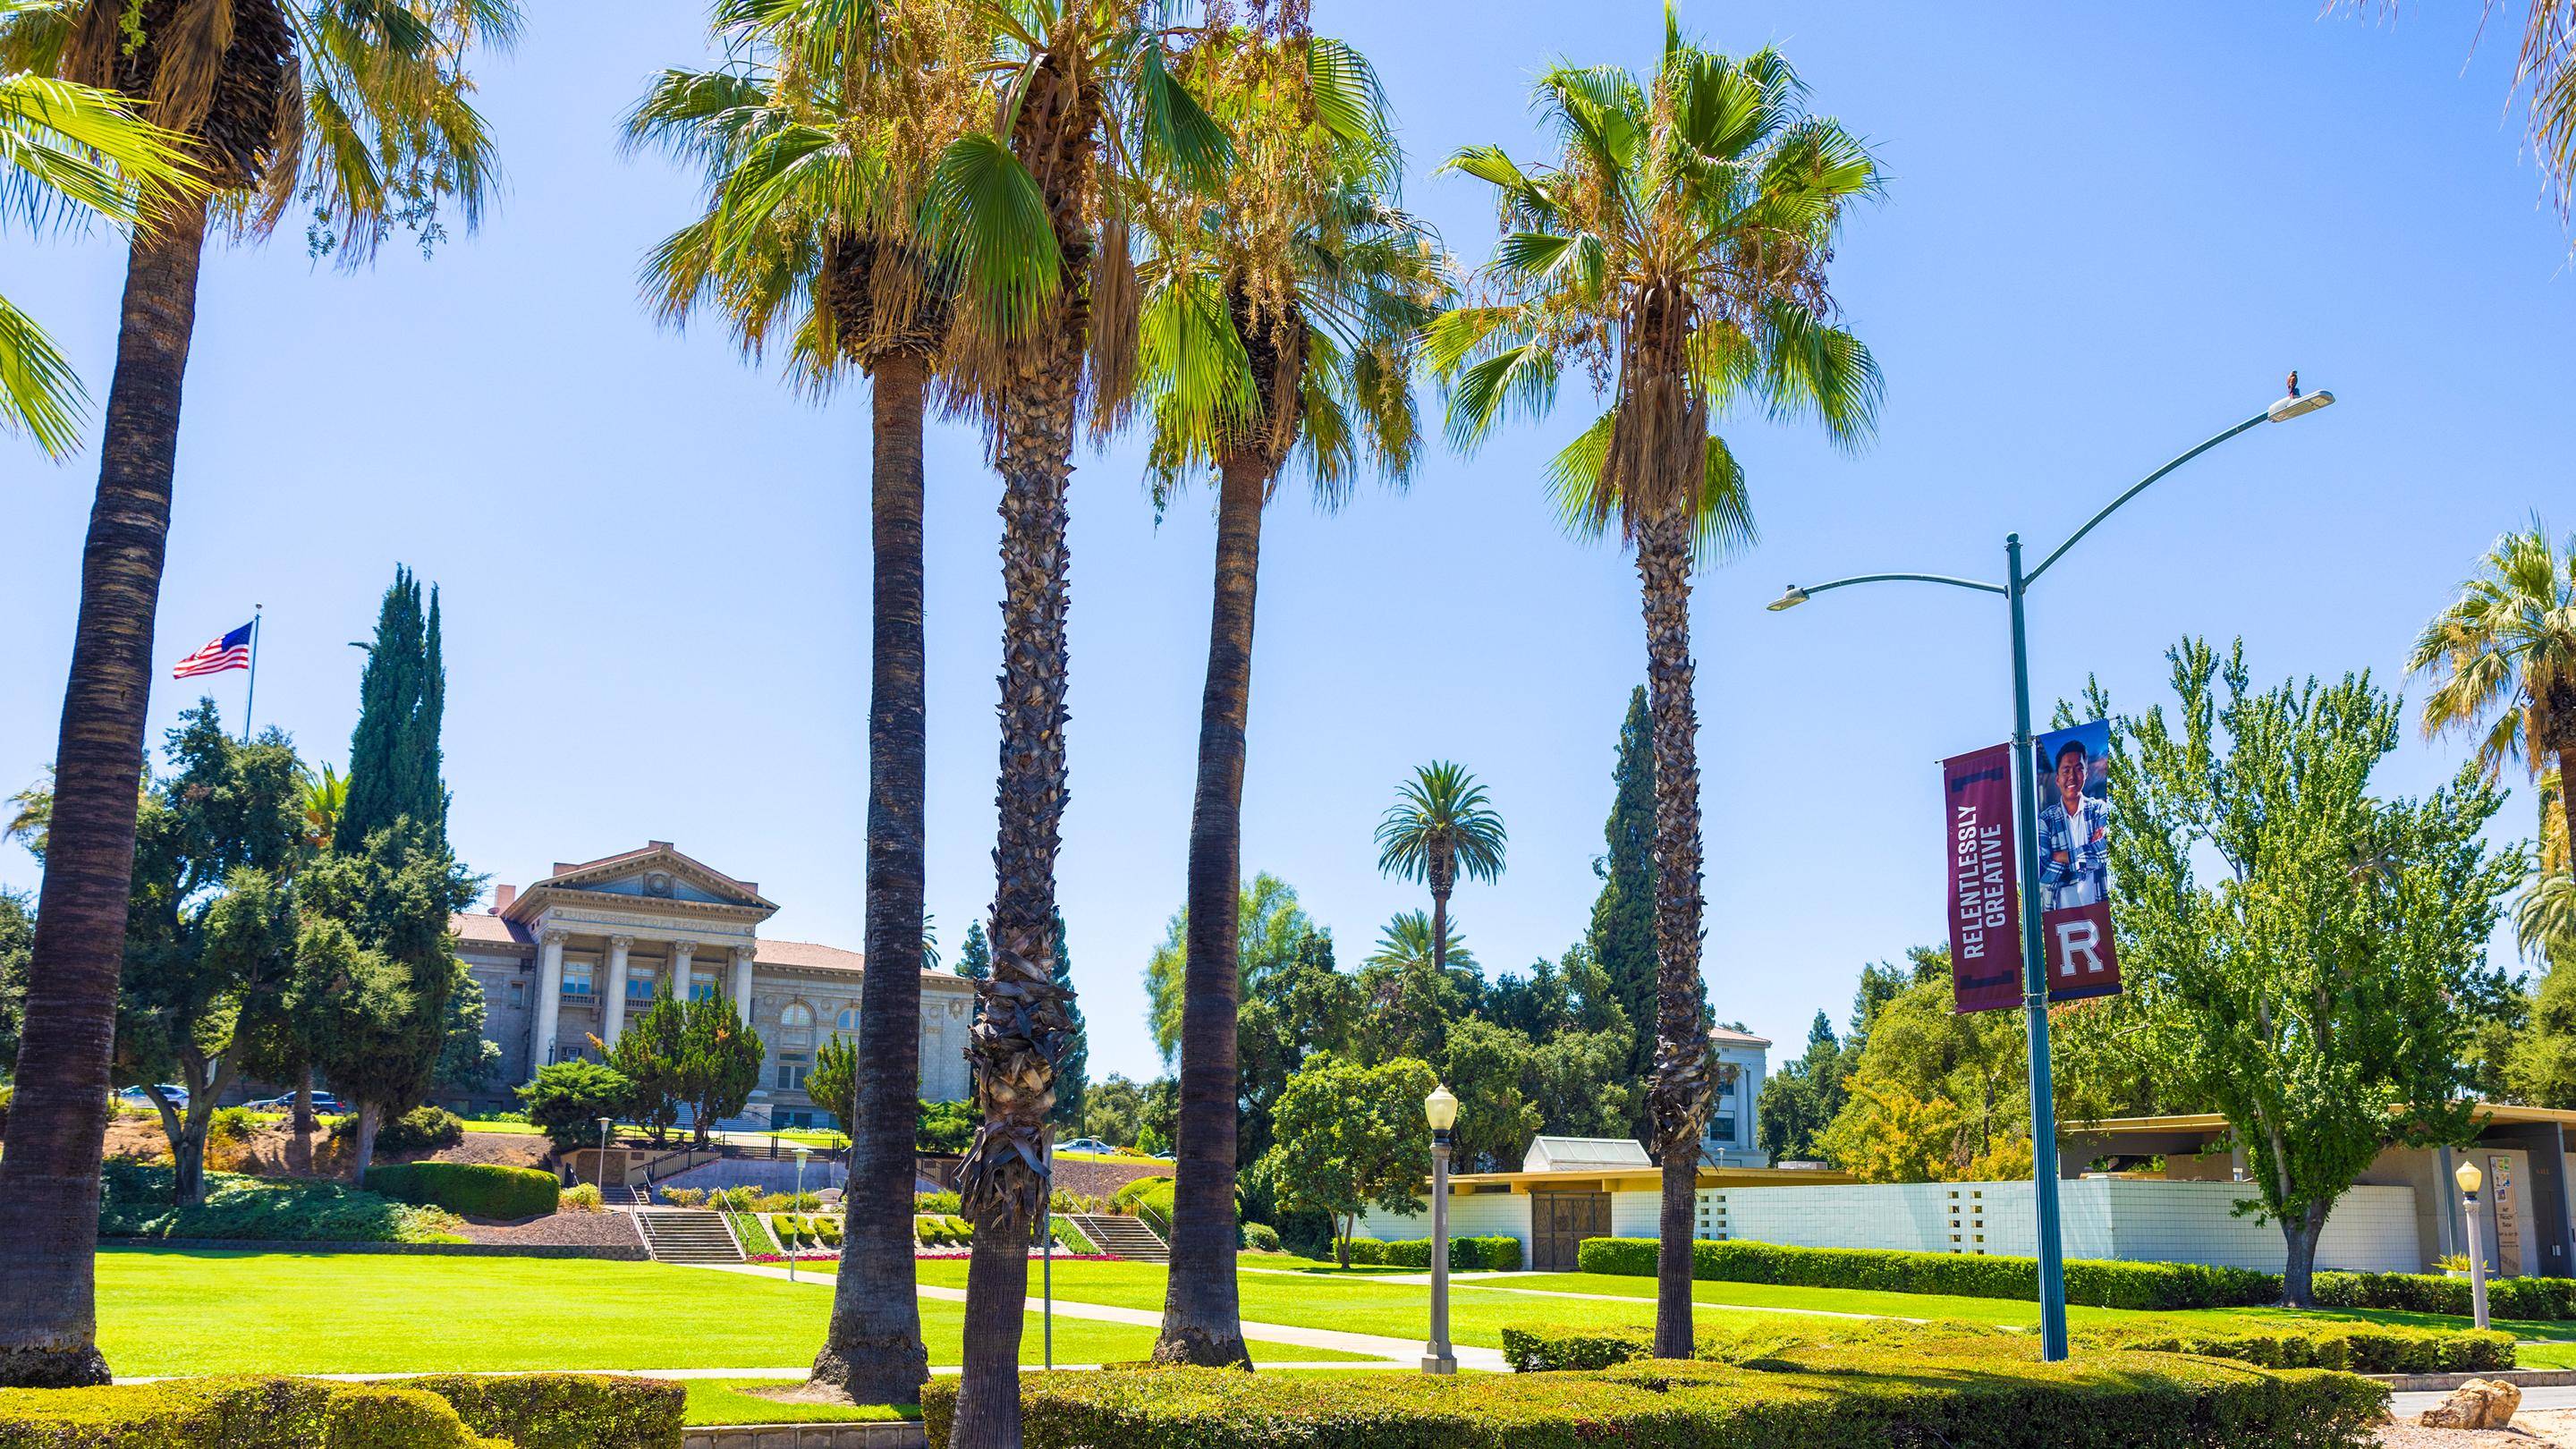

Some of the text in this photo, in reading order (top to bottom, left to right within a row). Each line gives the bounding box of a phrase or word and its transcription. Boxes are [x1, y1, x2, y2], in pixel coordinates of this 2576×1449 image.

[1958, 805, 1984, 959] RELENTLESSLY
[1979, 824, 2006, 928] CREATIVE
[2055, 919, 2104, 977] R
